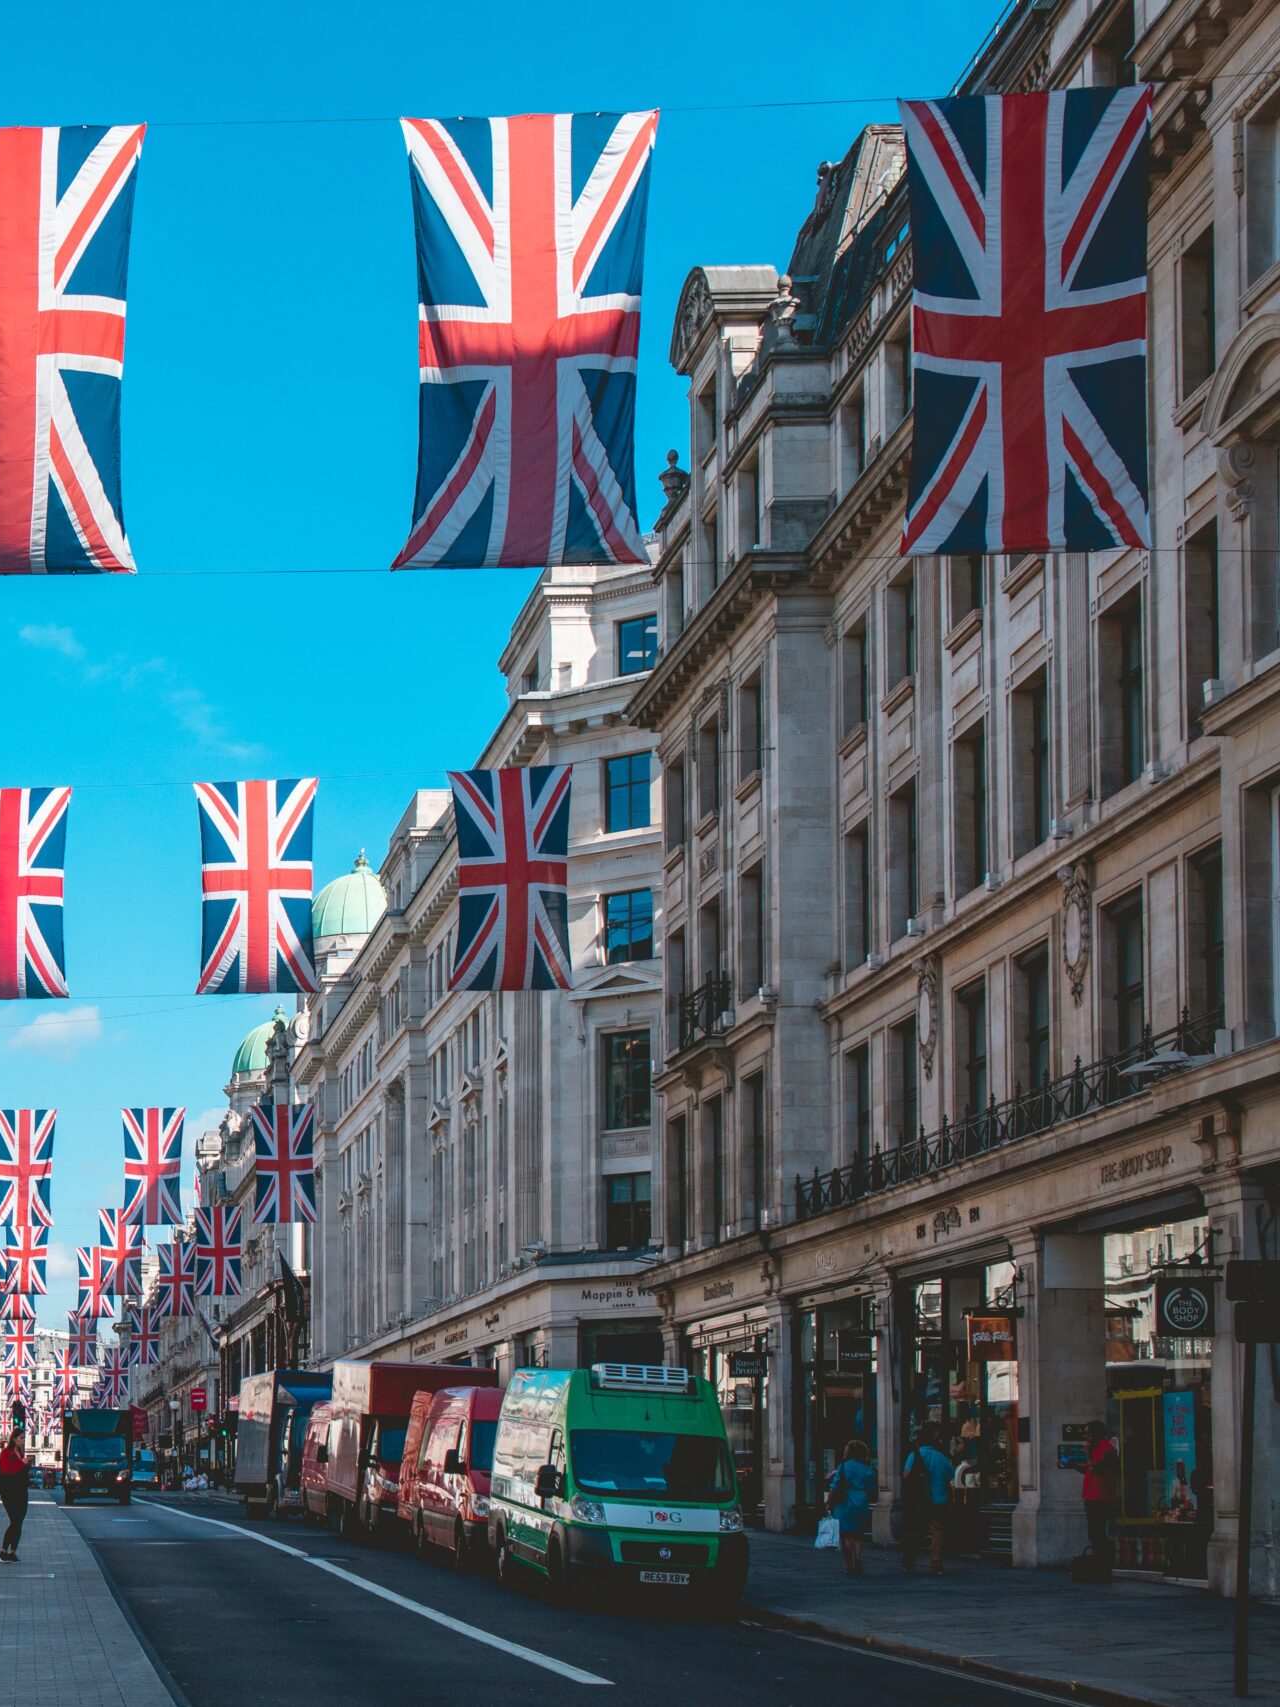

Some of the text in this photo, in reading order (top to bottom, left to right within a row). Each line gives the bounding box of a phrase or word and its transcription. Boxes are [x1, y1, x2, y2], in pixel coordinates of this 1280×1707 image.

[581, 1288, 622, 1302] Mappin
[626, 1288, 633, 1298] &
[1173, 1306, 1200, 1315] BODY
[1174, 1314, 1199, 1322] SHOP
